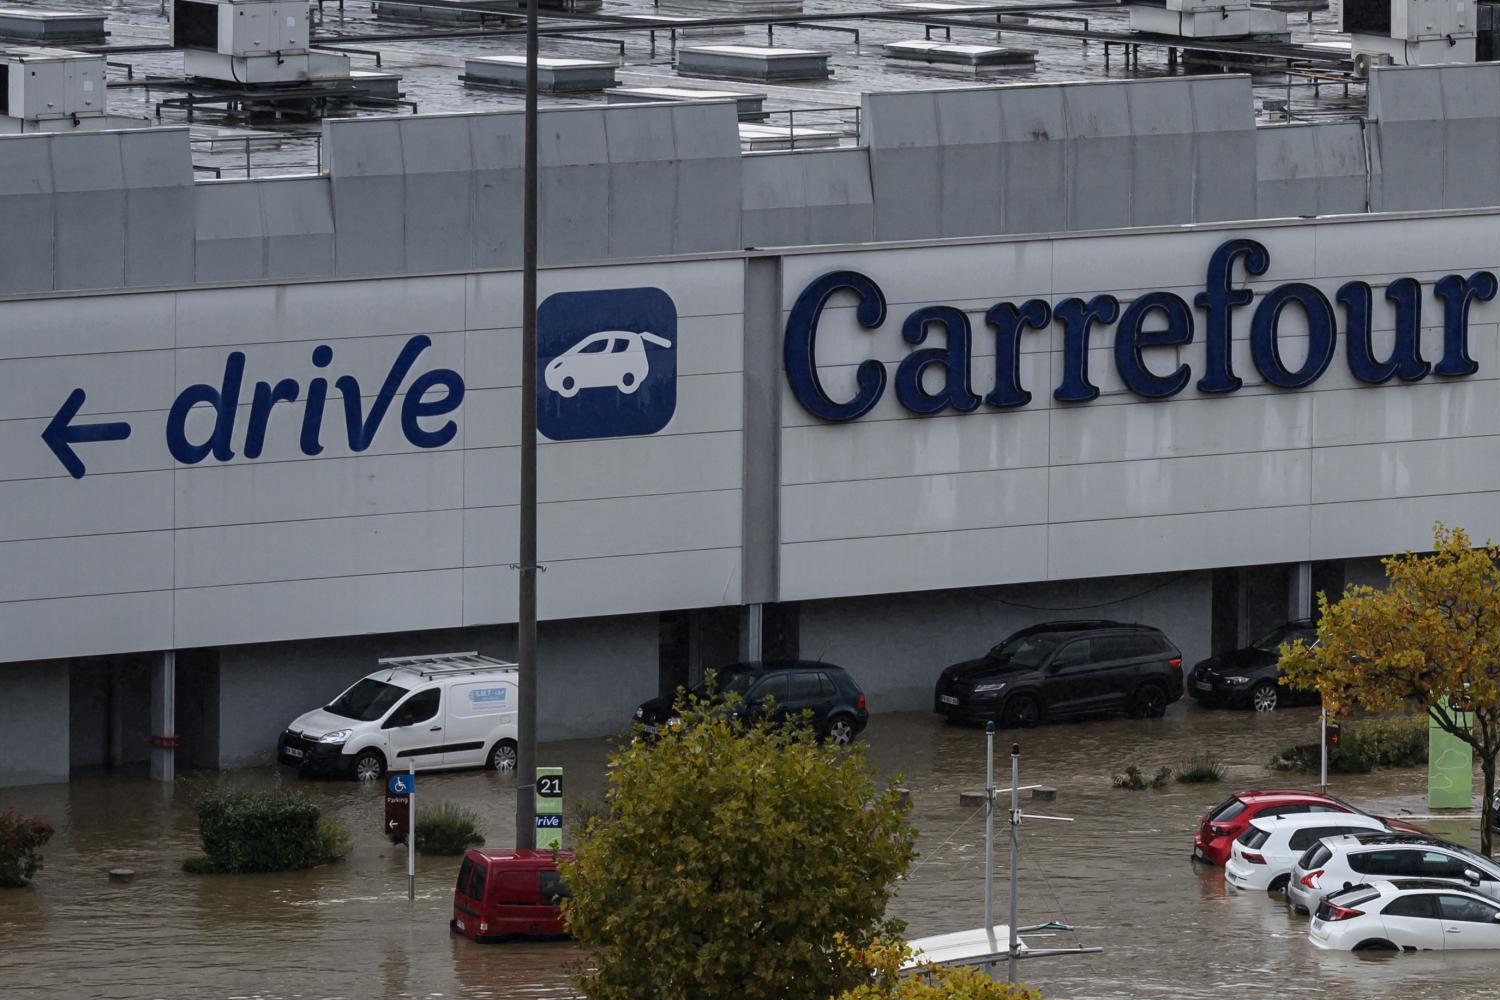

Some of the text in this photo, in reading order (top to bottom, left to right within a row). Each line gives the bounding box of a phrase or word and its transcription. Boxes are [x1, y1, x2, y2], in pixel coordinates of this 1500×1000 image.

[783, 239, 1498, 423] Carrefour
[167, 335, 465, 465] drive
[536, 816, 559, 826] rive
[540, 779, 561, 793] 21
